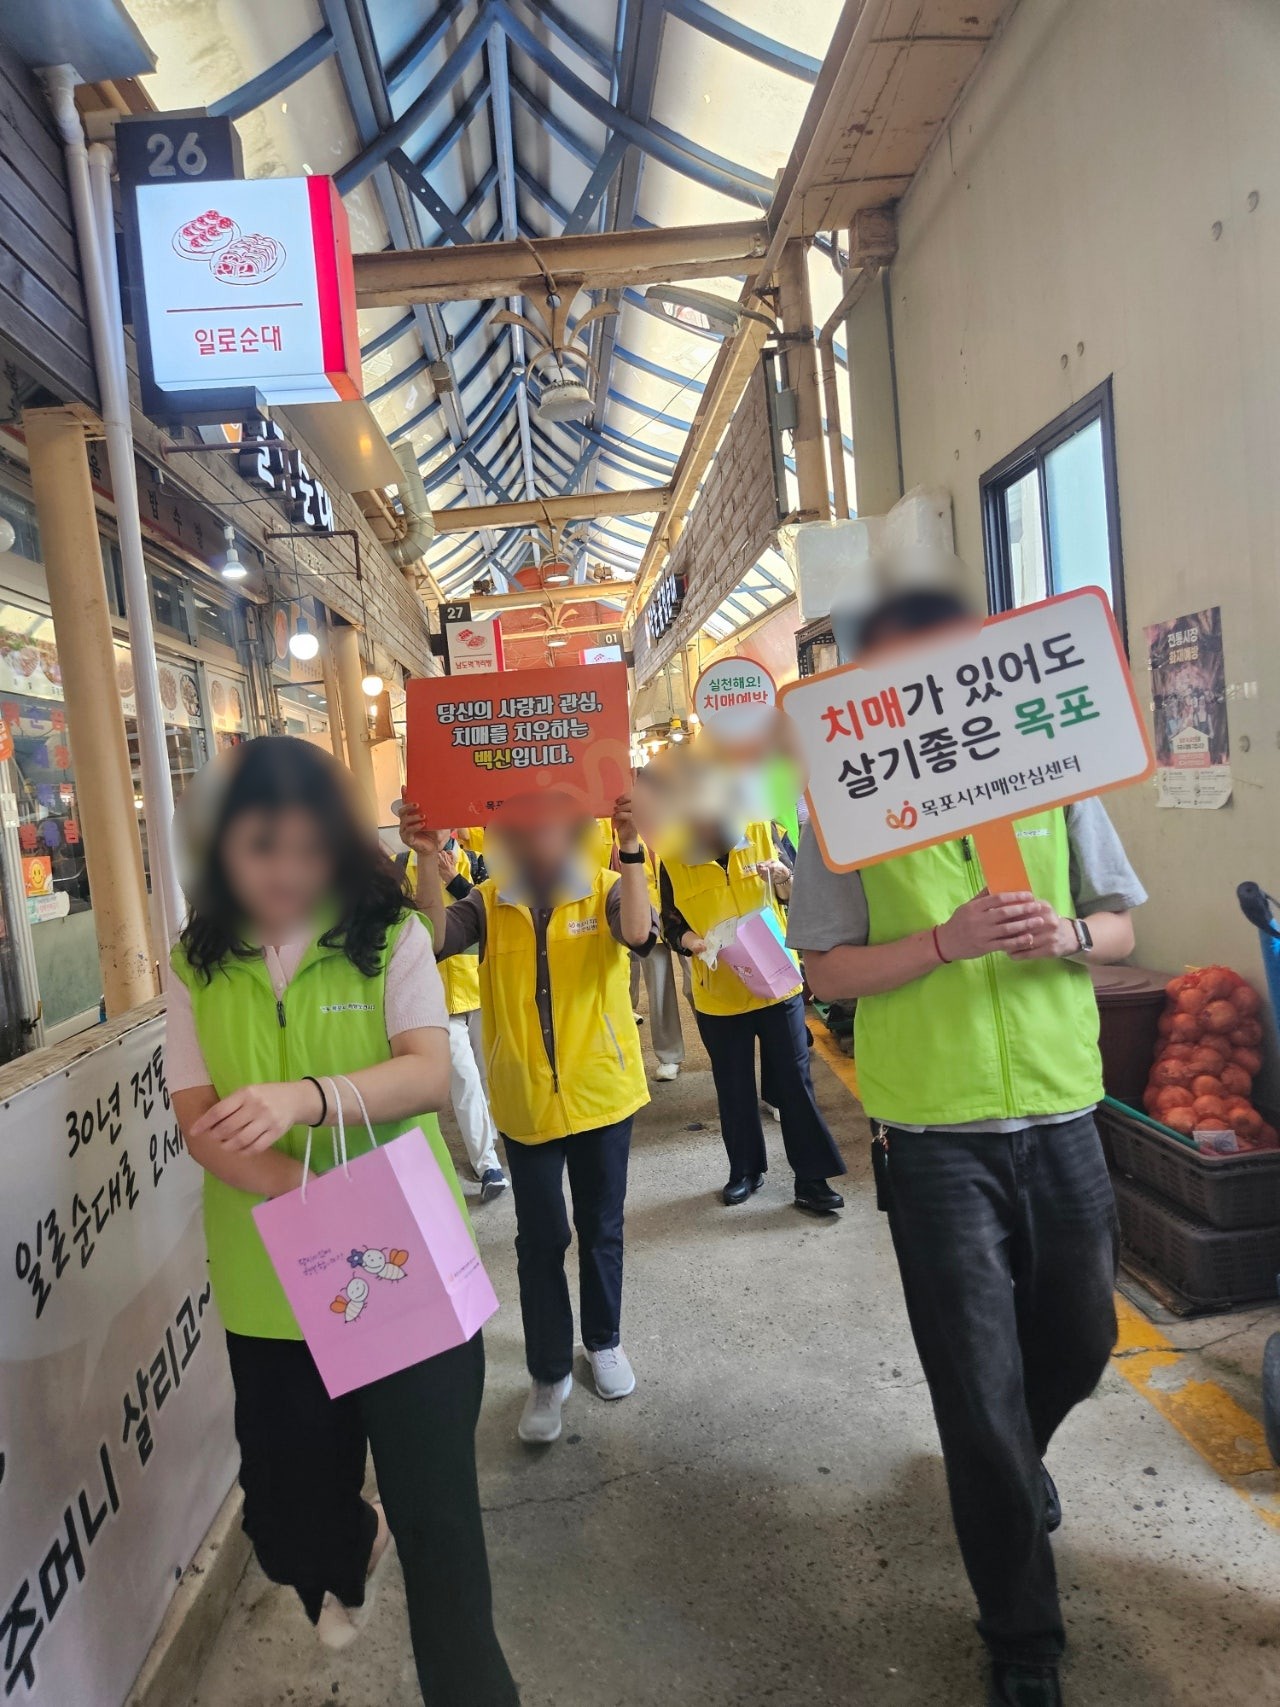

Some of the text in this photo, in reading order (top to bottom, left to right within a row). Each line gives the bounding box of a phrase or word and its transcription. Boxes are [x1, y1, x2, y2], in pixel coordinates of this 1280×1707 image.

[146, 132, 208, 177] 26
[194, 324, 282, 356] 일로순대
[447, 607, 463, 620] 27
[605, 633, 618, 644] 01
[1167, 627, 1198, 648] 전통시장
[709, 676, 760, 692] 실천해요!
[819, 631, 1086, 744] 치매가 있어도
[437, 690, 603, 724] 당신의 사랑과 관심,
[452, 717, 589, 747] 치매를 치유하는
[837, 684, 1100, 800] 살기좋은 목포
[474, 745, 574, 770] 백신입니다.
[921, 753, 1082, 818] 목포시치매안심센터
[66, 1044, 170, 1158] 30년 전통
[0, 1280, 211, 1697] 주머니 살리고~
